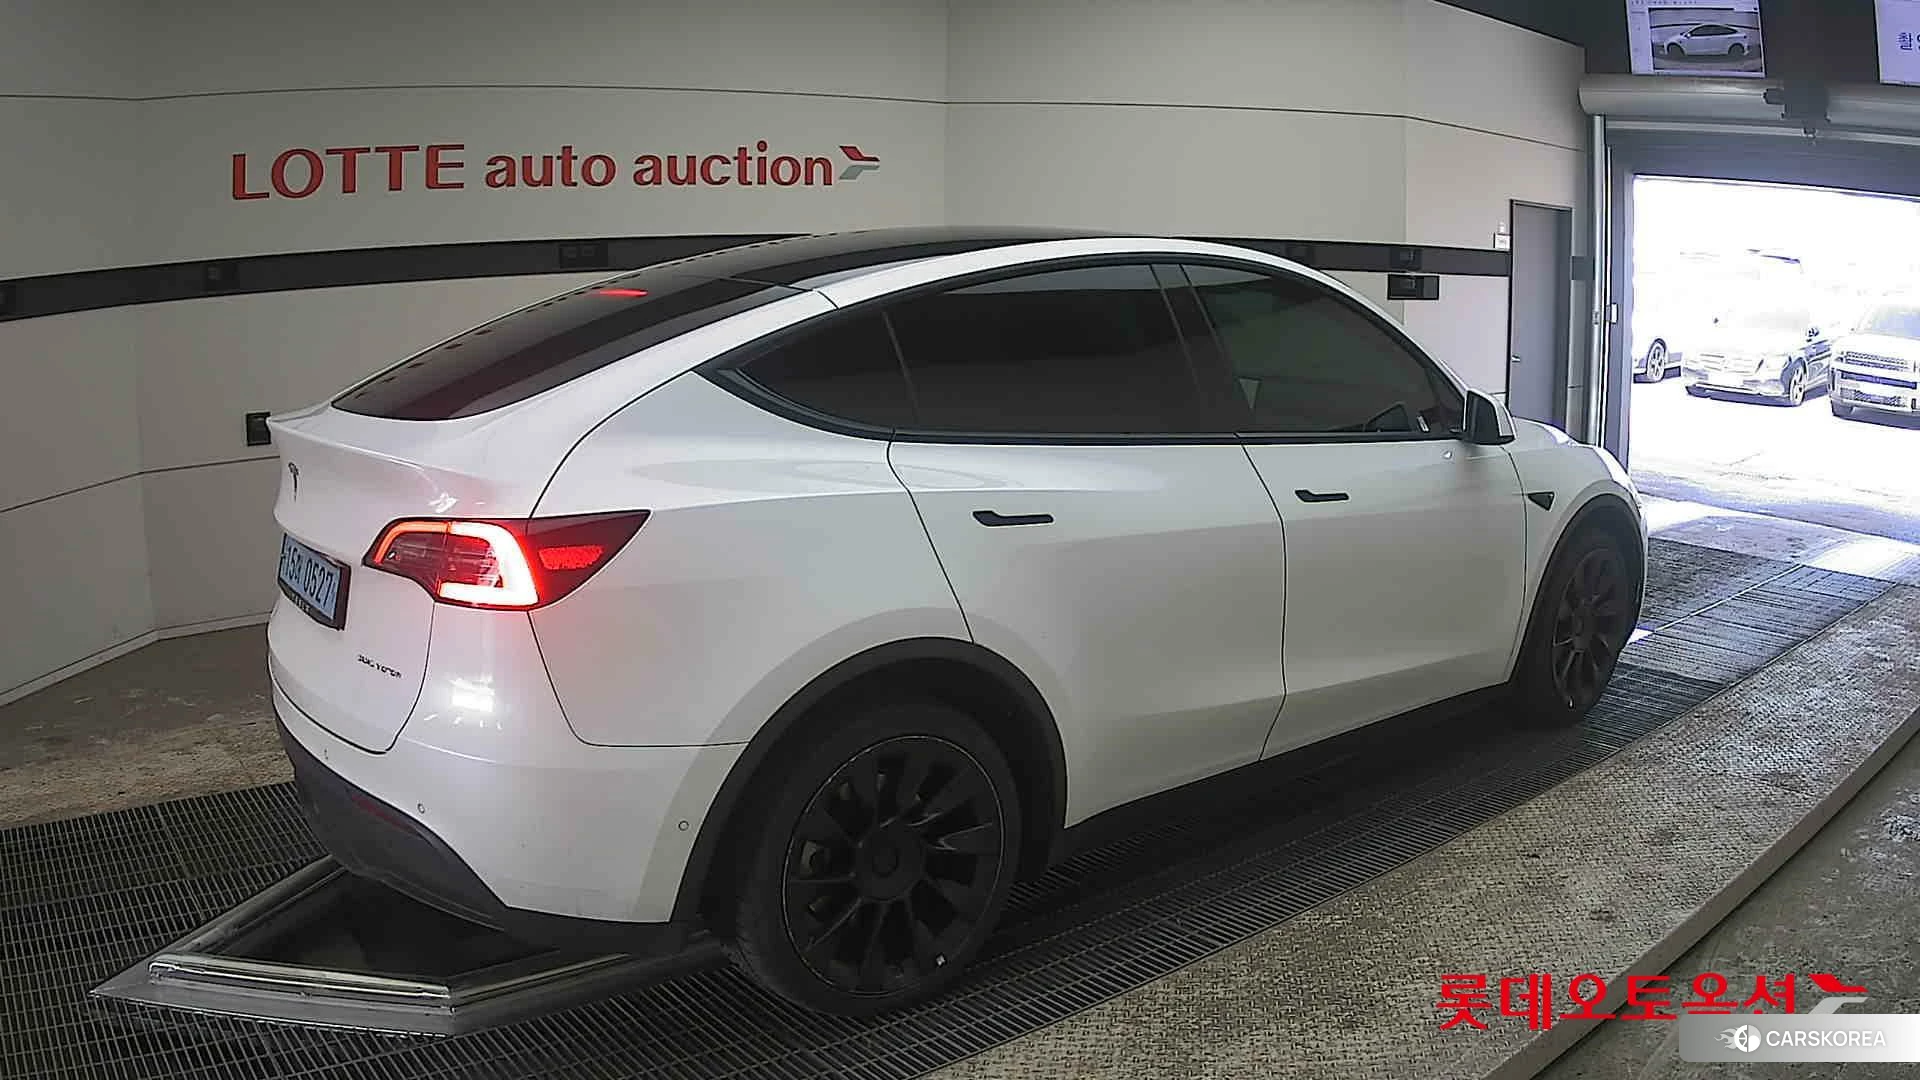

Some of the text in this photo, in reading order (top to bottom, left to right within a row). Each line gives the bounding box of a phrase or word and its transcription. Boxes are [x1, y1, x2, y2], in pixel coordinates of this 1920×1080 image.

[232, 140, 833, 199] LOTTE auto auction
[304, 558, 334, 608] 0527
